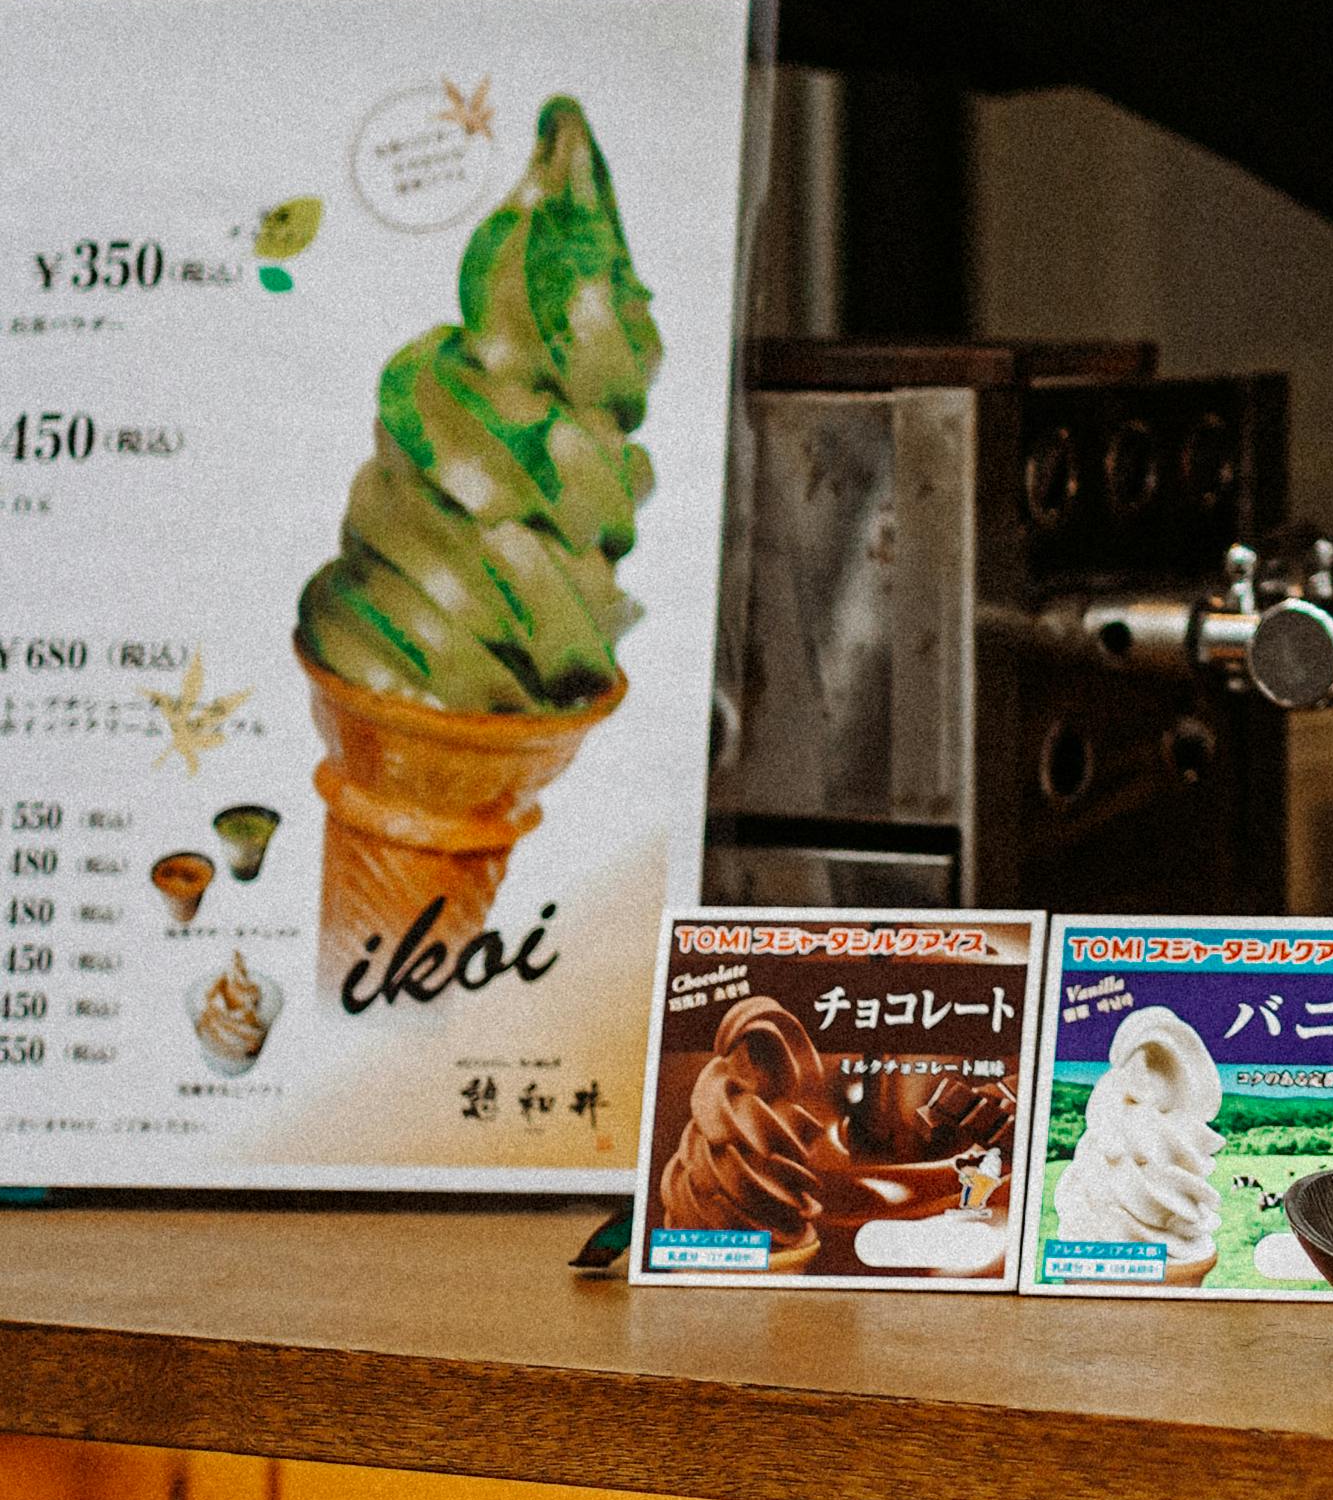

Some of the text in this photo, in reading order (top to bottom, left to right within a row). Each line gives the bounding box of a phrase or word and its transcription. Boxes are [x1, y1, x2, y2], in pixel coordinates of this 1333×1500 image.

[340, 895, 560, 1015] ikoi
[674, 926, 751, 955] TOMI
[1068, 937, 1144, 962] TOMI
[814, 986, 1016, 1034] チョコレート
